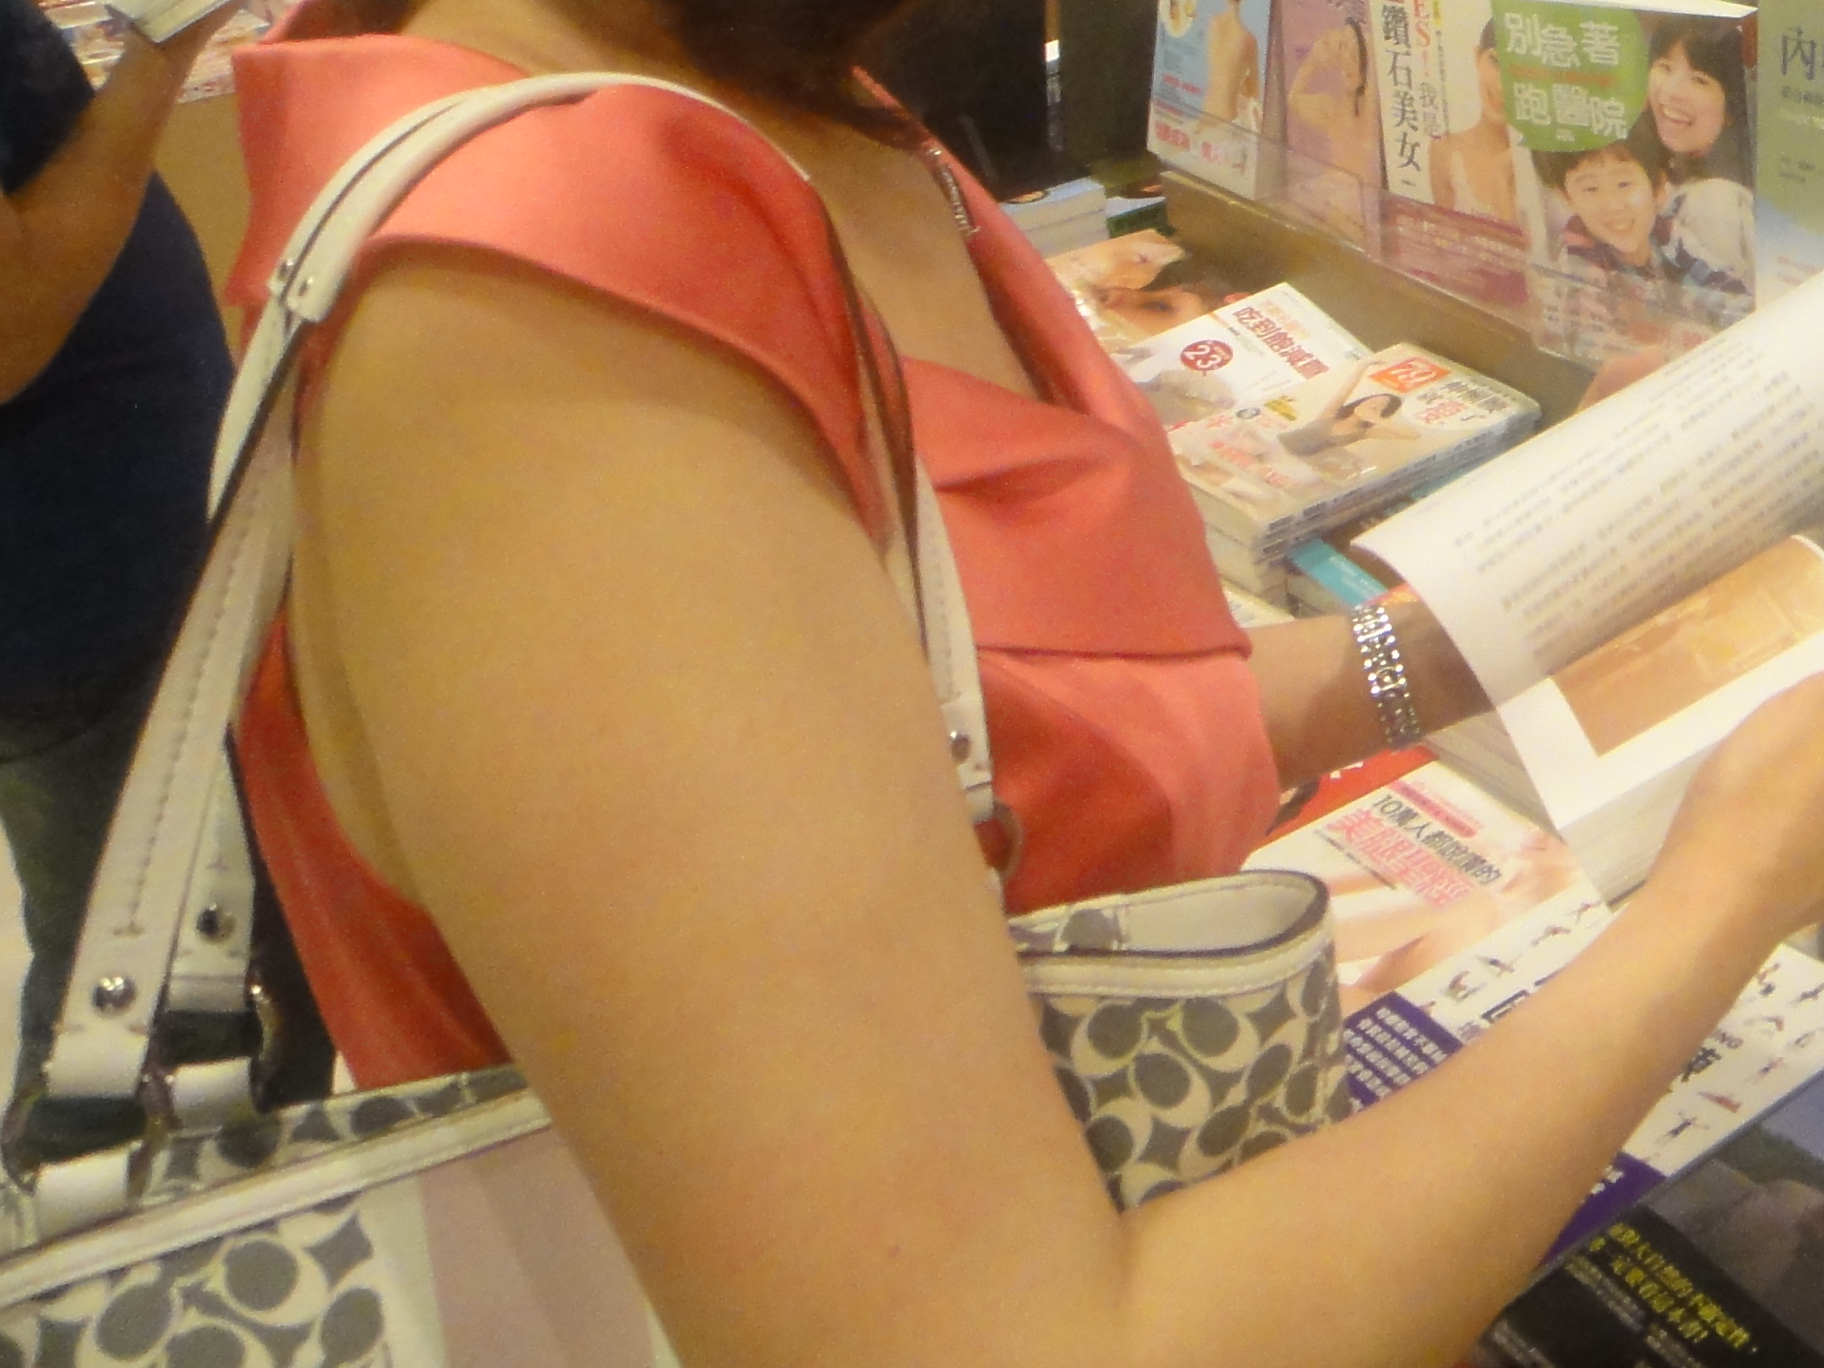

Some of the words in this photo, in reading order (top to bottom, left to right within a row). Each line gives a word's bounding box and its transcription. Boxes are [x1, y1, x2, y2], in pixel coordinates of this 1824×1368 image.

[1504, 12, 1620, 68] 別急著
[1513, 82, 1628, 140] 跑醫院
[1184, 344, 1223, 370] 23
